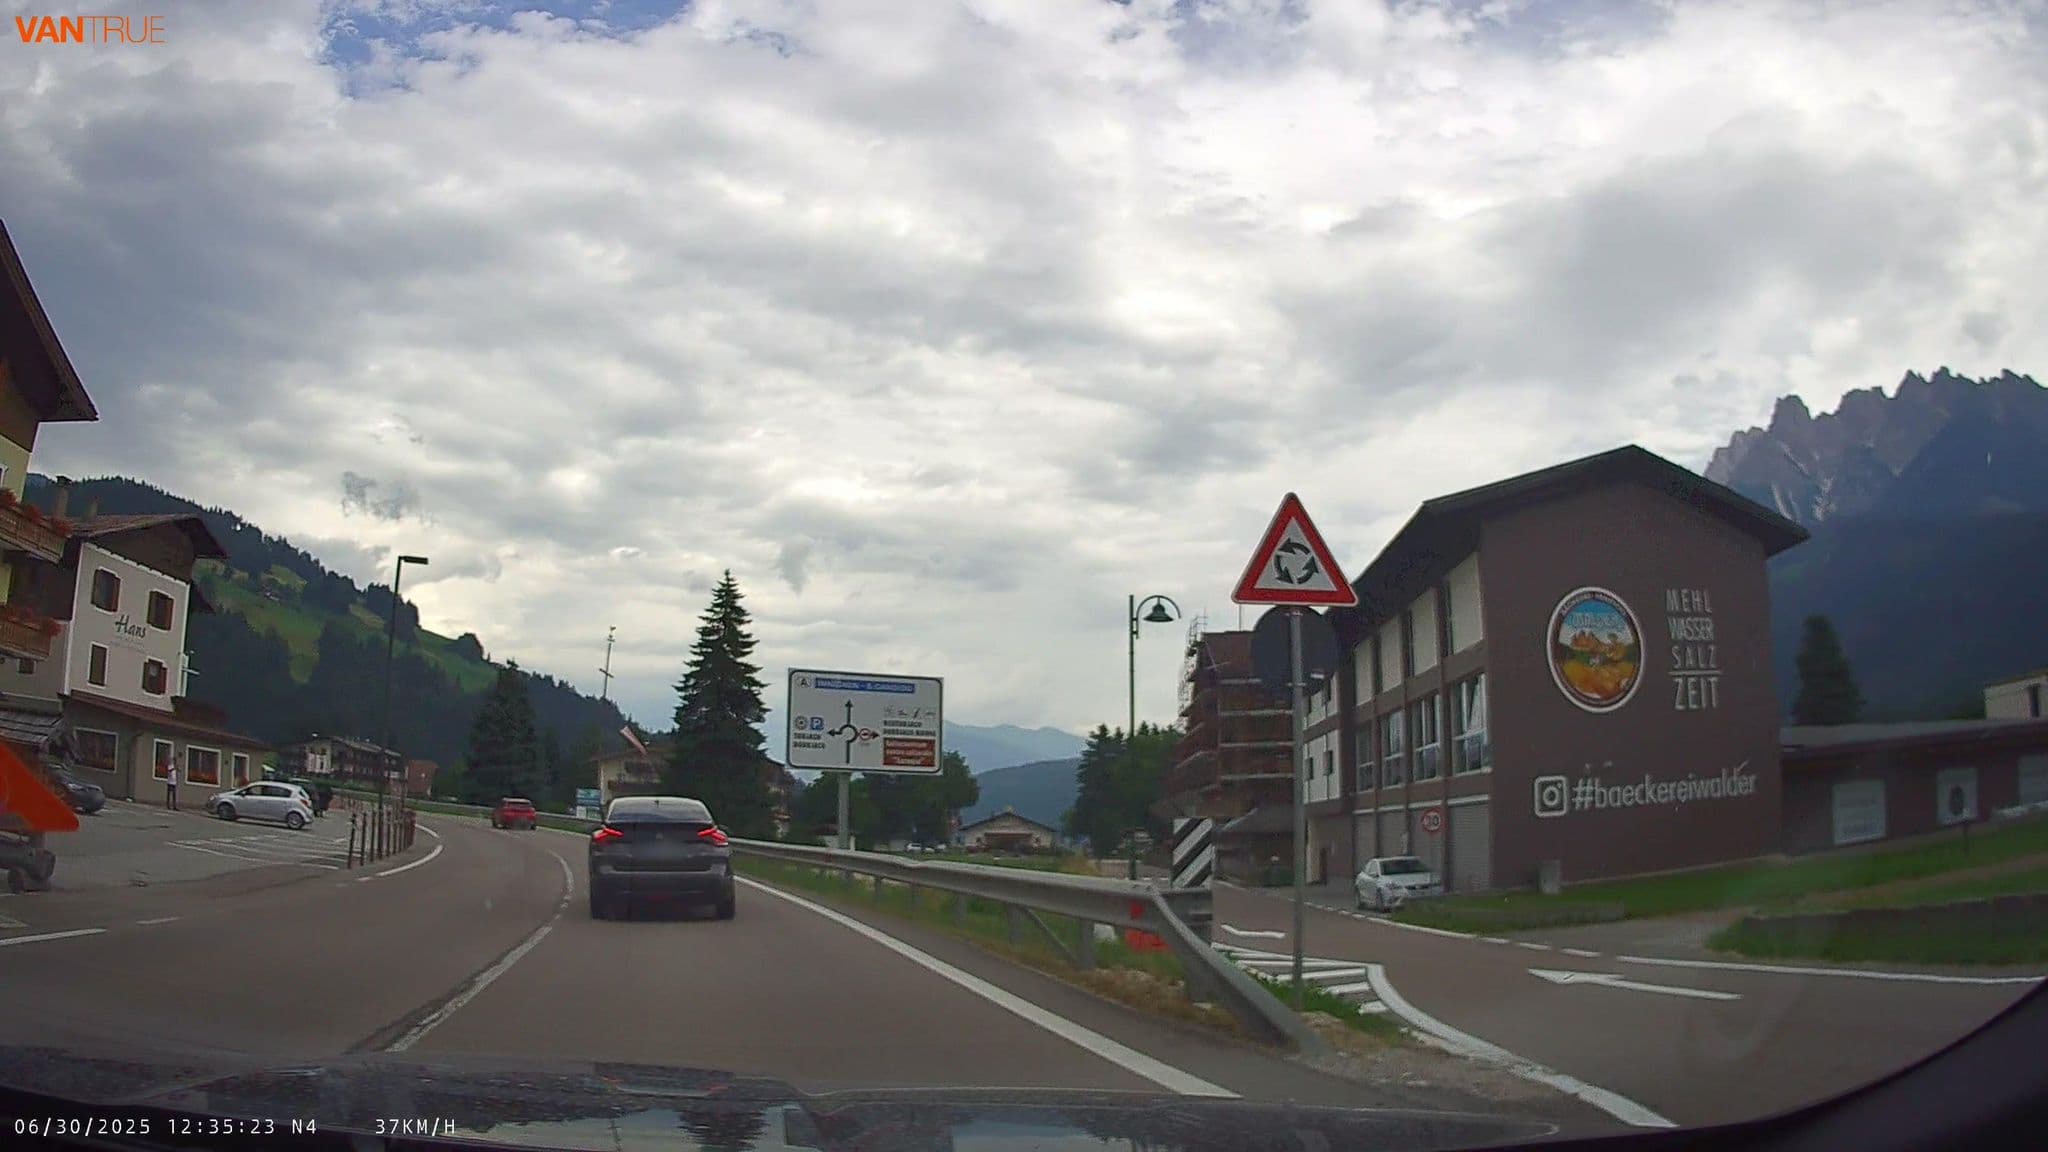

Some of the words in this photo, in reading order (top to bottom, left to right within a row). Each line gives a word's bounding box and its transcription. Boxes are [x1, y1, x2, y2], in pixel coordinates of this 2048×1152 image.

[1665, 588, 1712, 613] MEHL
[115, 614, 146, 638] Hans
[1666, 616, 1714, 641] WASSER
[1671, 644, 1717, 669] SALZ
[1673, 676, 1718, 709] ZEIT
[1571, 770, 1758, 810] #baeckereiwalder
